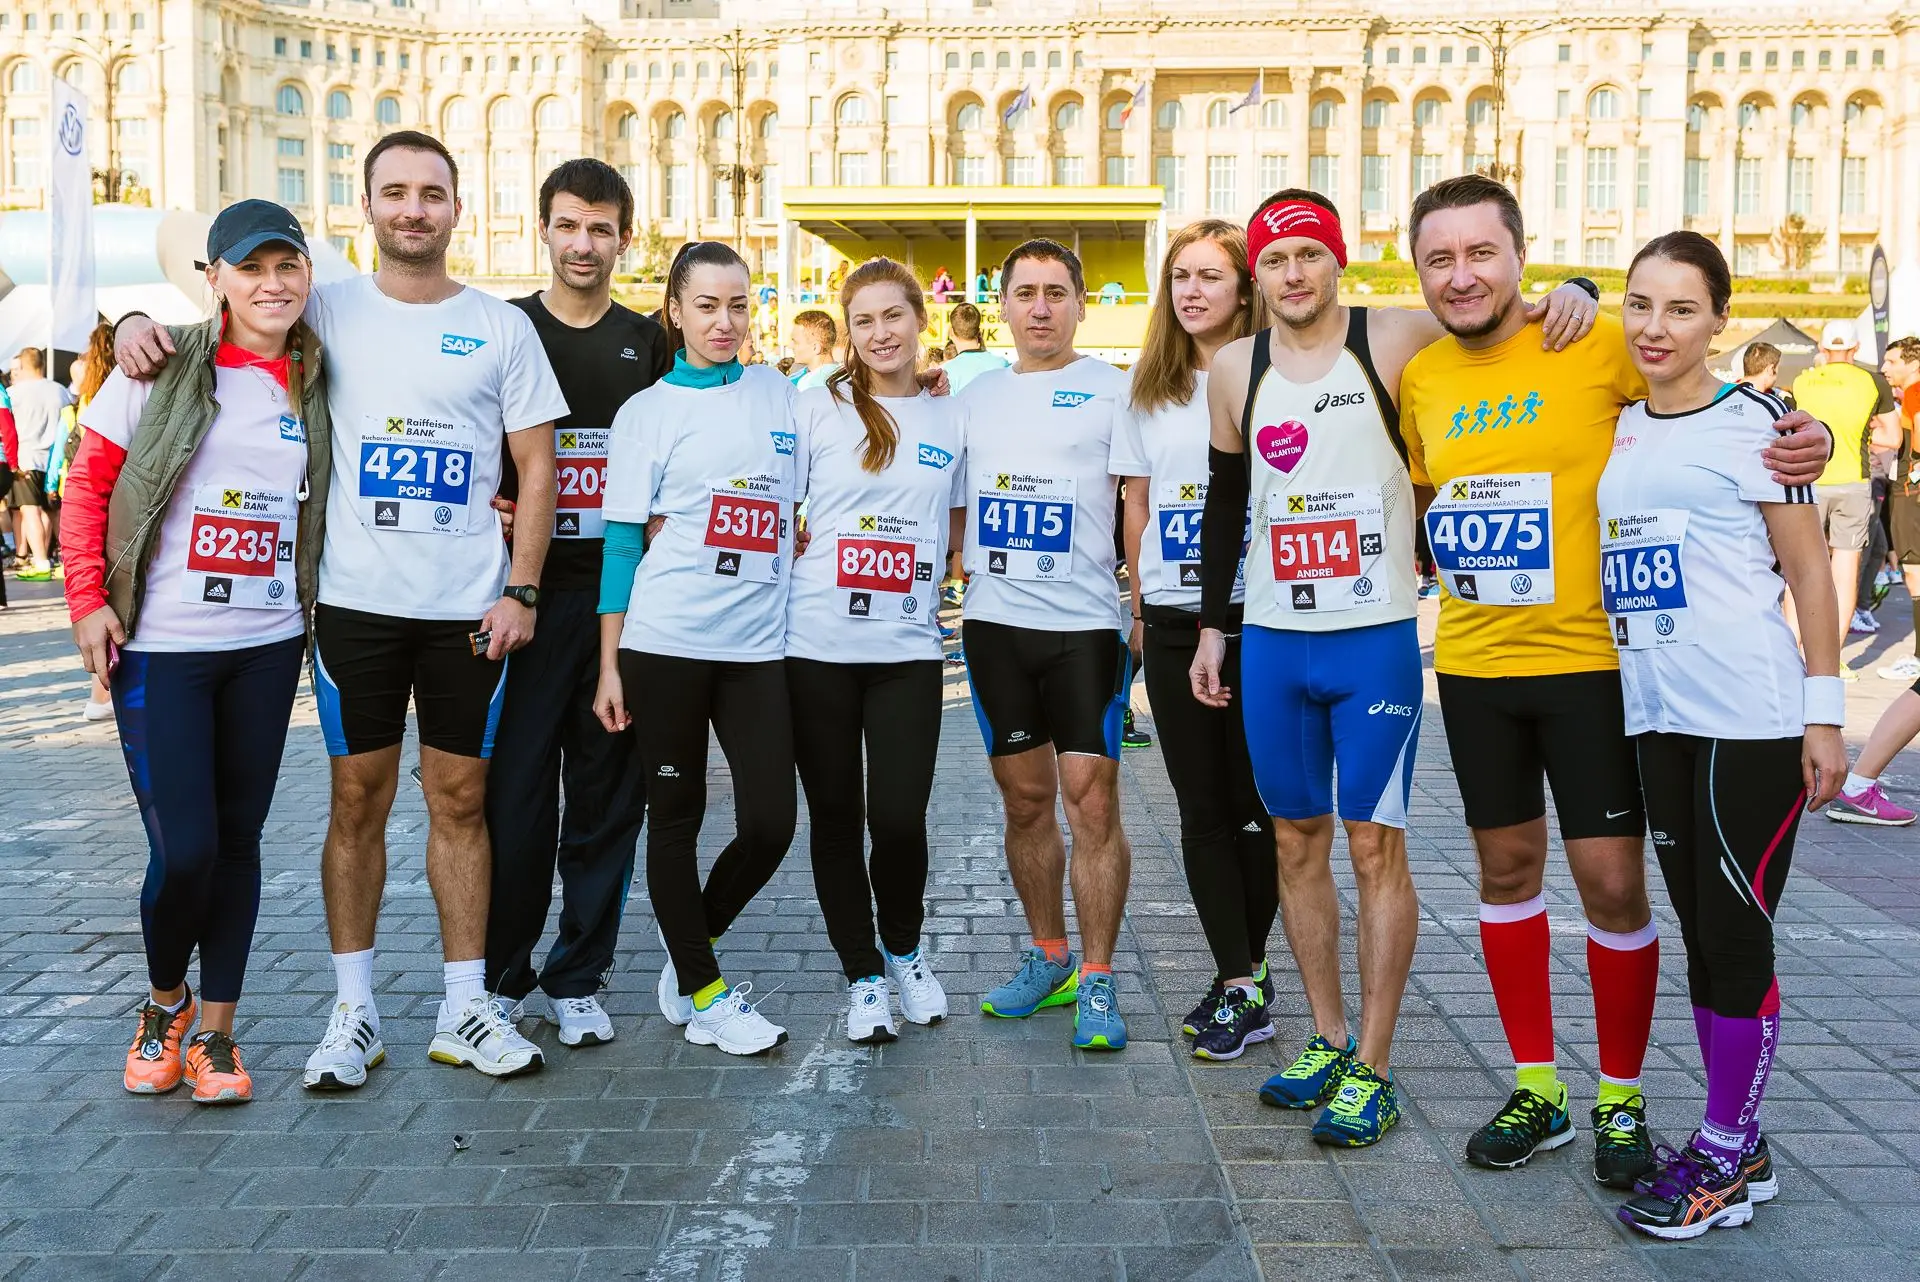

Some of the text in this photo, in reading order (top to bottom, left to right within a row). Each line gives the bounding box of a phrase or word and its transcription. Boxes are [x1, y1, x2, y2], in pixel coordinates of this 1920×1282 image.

[442, 337, 477, 354] SAP
[1054, 394, 1084, 406] SAP
[1330, 392, 1365, 408] asics
[1724, 407, 1744, 416] adidas
[406, 418, 454, 430] Raiffeisen
[406, 428, 436, 438] BANK
[426, 439, 460, 448] MARATHON
[1271, 436, 1292, 448] #SUNT
[919, 448, 948, 467] SAP
[1266, 446, 1302, 460] GALANTOM
[364, 446, 466, 487] 4218
[1012, 474, 1052, 484] Raiffeisen
[1470, 480, 1521, 488] Raiffeisen
[398, 486, 432, 498] POPE
[749, 483, 771, 492] BANK
[1012, 484, 1036, 492] BANK
[244, 491, 284, 502] Raiffeisen
[1306, 492, 1354, 502] Raiffeisen
[1470, 490, 1502, 500] BANK
[244, 502, 268, 511] BANK
[1308, 502, 1336, 512] BANK
[1492, 500, 1530, 508] MARATHON
[194, 506, 228, 514] Bucharest
[1328, 510, 1364, 518] MARATHON
[714, 504, 776, 540] 5312
[877, 516, 918, 526] Raiffeisen
[984, 501, 1064, 536] 4115
[1619, 515, 1658, 527] Raiffeisen
[878, 524, 902, 534] BANK
[1434, 512, 1543, 552] 4075
[1620, 527, 1642, 538] BANK
[195, 524, 274, 562] 8235
[1006, 537, 1033, 548] ALIN
[1635, 536, 1665, 546] MARATHON
[1280, 530, 1350, 566] 5114
[842, 546, 911, 580] 8203
[1458, 556, 1518, 568] BOGDAN
[1296, 568, 1334, 578] ANDREI
[1604, 548, 1676, 593] 4168
[1616, 595, 1658, 610] SIMONA
[1384, 704, 1412, 716] asics
[1738, 1018, 1774, 1126] COMPRESSPORT
